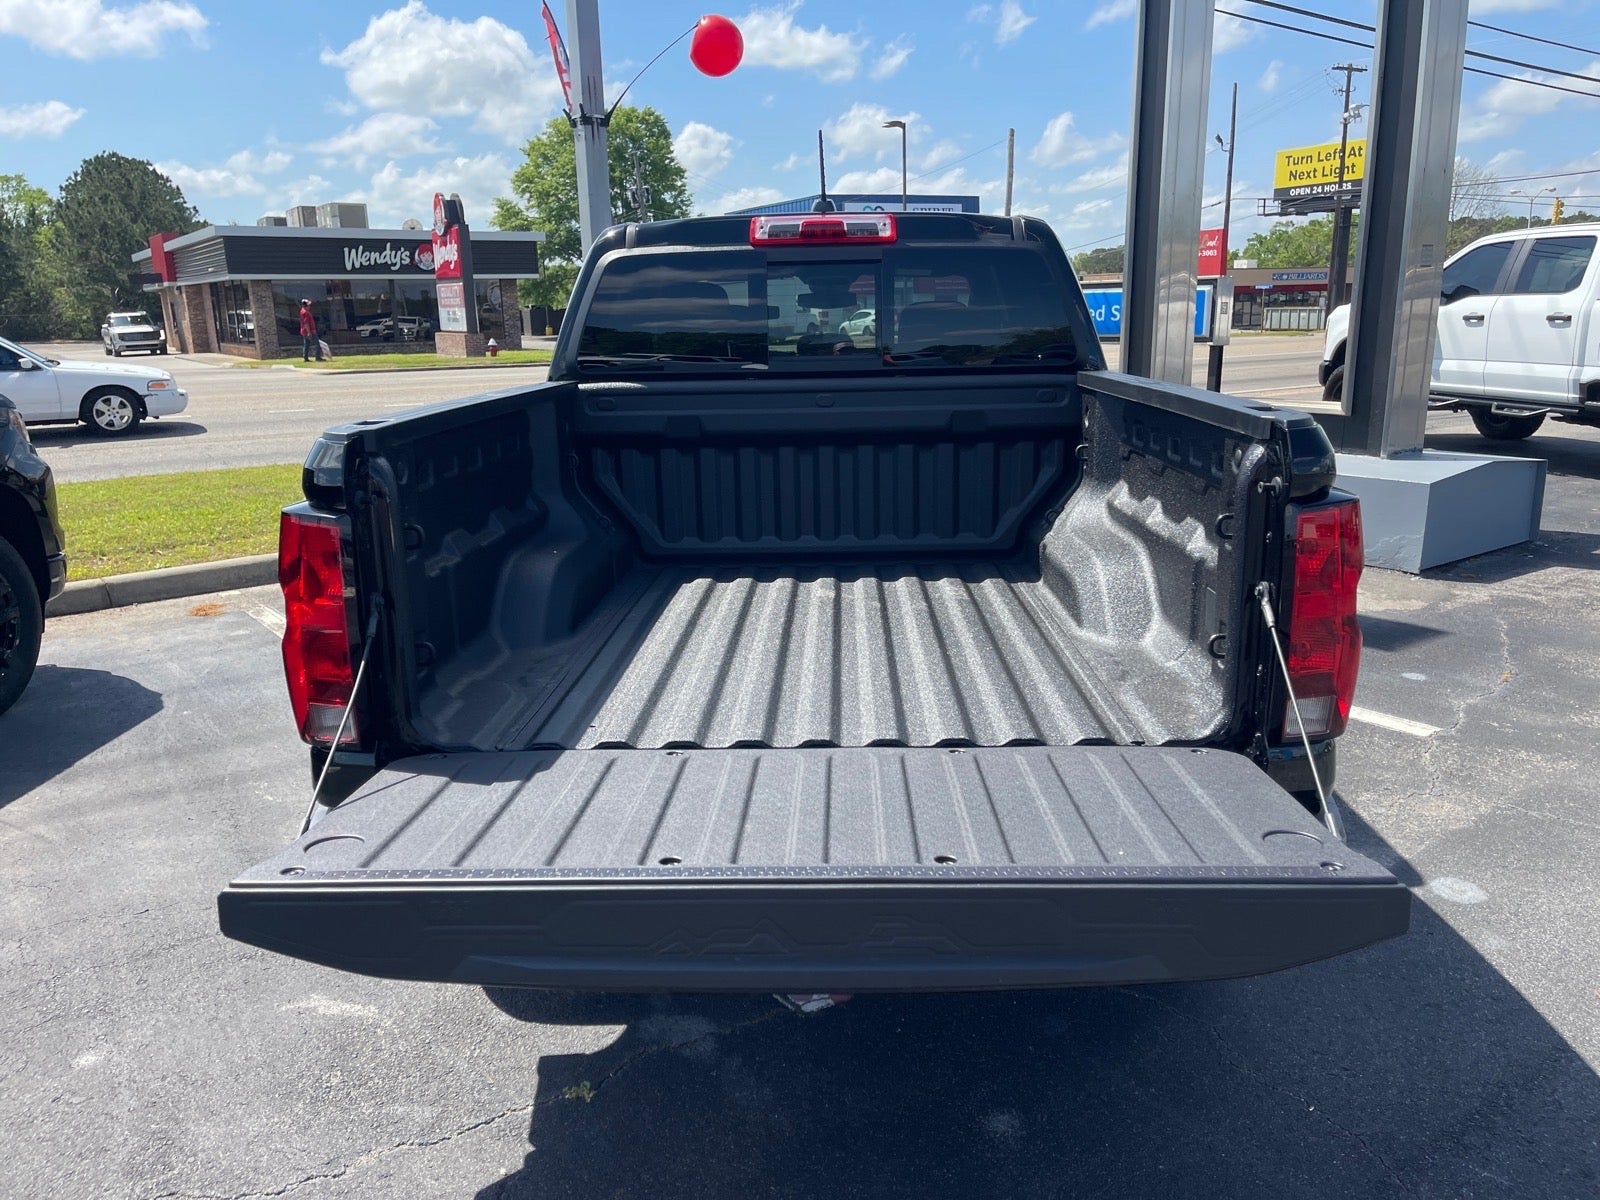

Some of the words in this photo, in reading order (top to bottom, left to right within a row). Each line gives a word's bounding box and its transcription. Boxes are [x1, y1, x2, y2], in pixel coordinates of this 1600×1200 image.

[1285, 154, 1313, 167] Turn
[1347, 145, 1364, 158] At
[1288, 167, 1318, 181] Next
[1289, 187, 1311, 196] OPEN
[1312, 185, 1322, 194] 24
[343, 242, 411, 271] Wendy's
[432, 235, 459, 271] Wendy's
